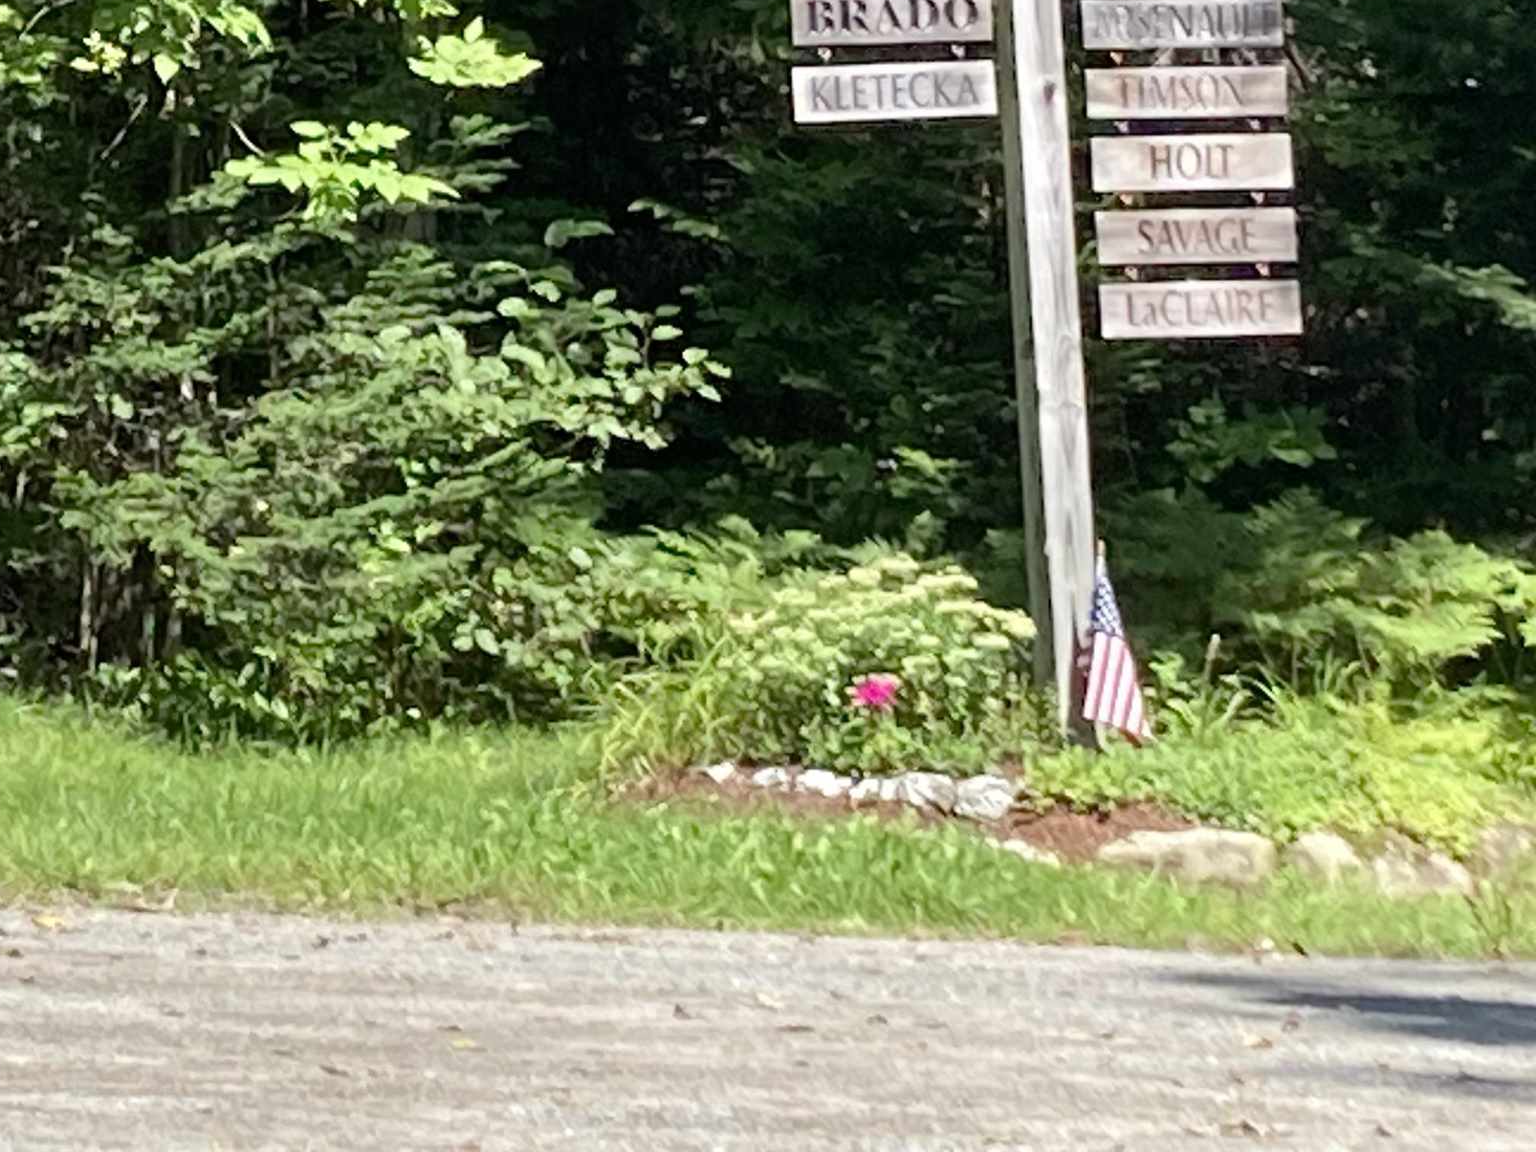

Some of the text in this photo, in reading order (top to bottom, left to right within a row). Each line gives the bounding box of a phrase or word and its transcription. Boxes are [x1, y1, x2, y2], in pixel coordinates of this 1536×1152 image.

[809, 70, 981, 111] KLETECKA
[1117, 74, 1245, 111] TIMSON
[1149, 142, 1235, 181] HOLT
[1137, 217, 1258, 255] SAVAGE
